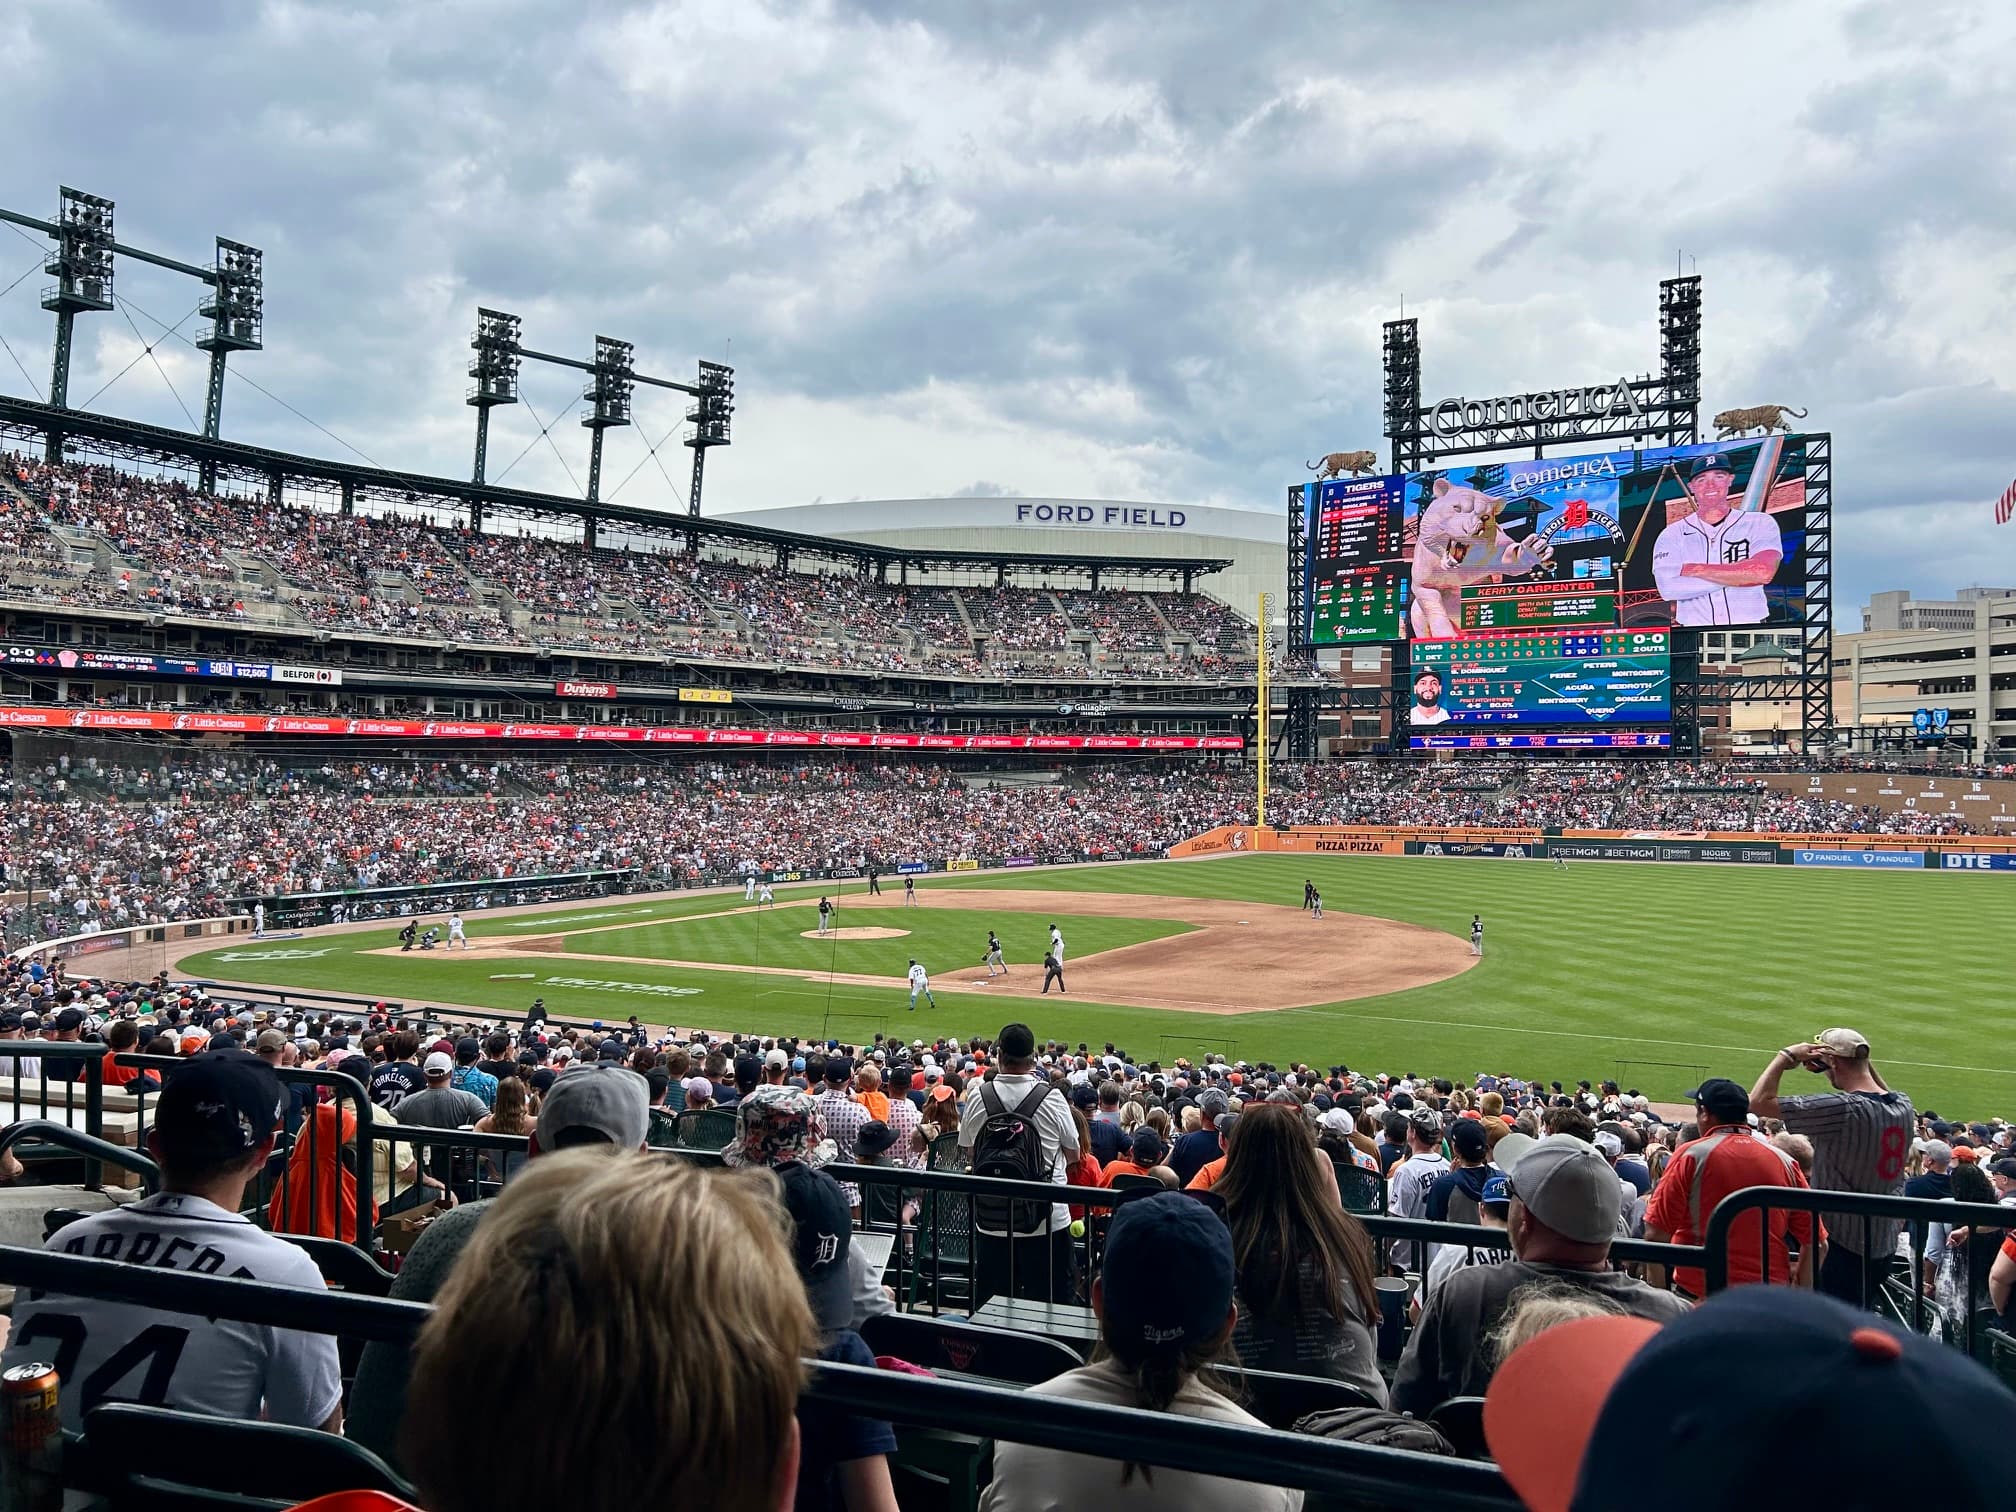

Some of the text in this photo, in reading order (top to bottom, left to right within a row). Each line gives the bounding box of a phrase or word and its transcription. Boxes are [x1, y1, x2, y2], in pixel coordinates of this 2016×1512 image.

[1486, 420, 1584, 443] PARK
[1344, 481, 1385, 493] TIGERS
[1017, 504, 1186, 527] FORD FIELD
[1592, 511, 1621, 539] TIGERS
[1355, 566, 1380, 574] SEASON
[1478, 582, 1595, 596] KERRY CARPENTER
[1633, 633, 1665, 644] 0-0
[10, 647, 35, 657] 0-0
[82, 660, 102, 668] .784
[96, 654, 153, 664] CARPENTER
[236, 667, 267, 678] $12,505
[282, 670, 315, 680] BELFOR
[563, 683, 609, 695] Dunham's
[834, 697, 870, 707] CHAMPIONS
[1074, 703, 1112, 712] Gallagher
[1585, 707, 1616, 715] QUERO
[10, 711, 47, 723] Caesars
[95, 713, 152, 726] Little Caesars
[194, 717, 245, 729] Little Caesars
[283, 720, 329, 731] Little Caesars
[363, 722, 405, 733] Little Caesars
[441, 724, 485, 735] Little Caesars
[591, 729, 629, 738] Little Caesars
[658, 731, 693, 740] Little Caesars
[720, 733, 753, 742] Little Caesars
[1037, 738, 1070, 746] Little Caesars
[1810, 776, 1820, 786] 23
[1887, 778, 1893, 787] 5
[1928, 780, 1935, 790] 2
[1971, 782, 1982, 792] 16
[1905, 798, 1916, 807] 47
[1949, 800, 1956, 810] 3
[2000, 803, 2006, 813] 1
[1316, 841, 1383, 851] PIZZA! PIZZA!
[1560, 848, 1599, 856] BETMGM
[1612, 848, 1654, 858] BETMGM
[1815, 854, 1853, 862] FANDUEL
[1875, 855, 1915, 863] FANDUEL
[1946, 855, 1991, 868] DTE
[773, 872, 800, 881] bet365
[1877, 1126, 1907, 1181] 8
[1143, 1324, 1185, 1344] Tigers
